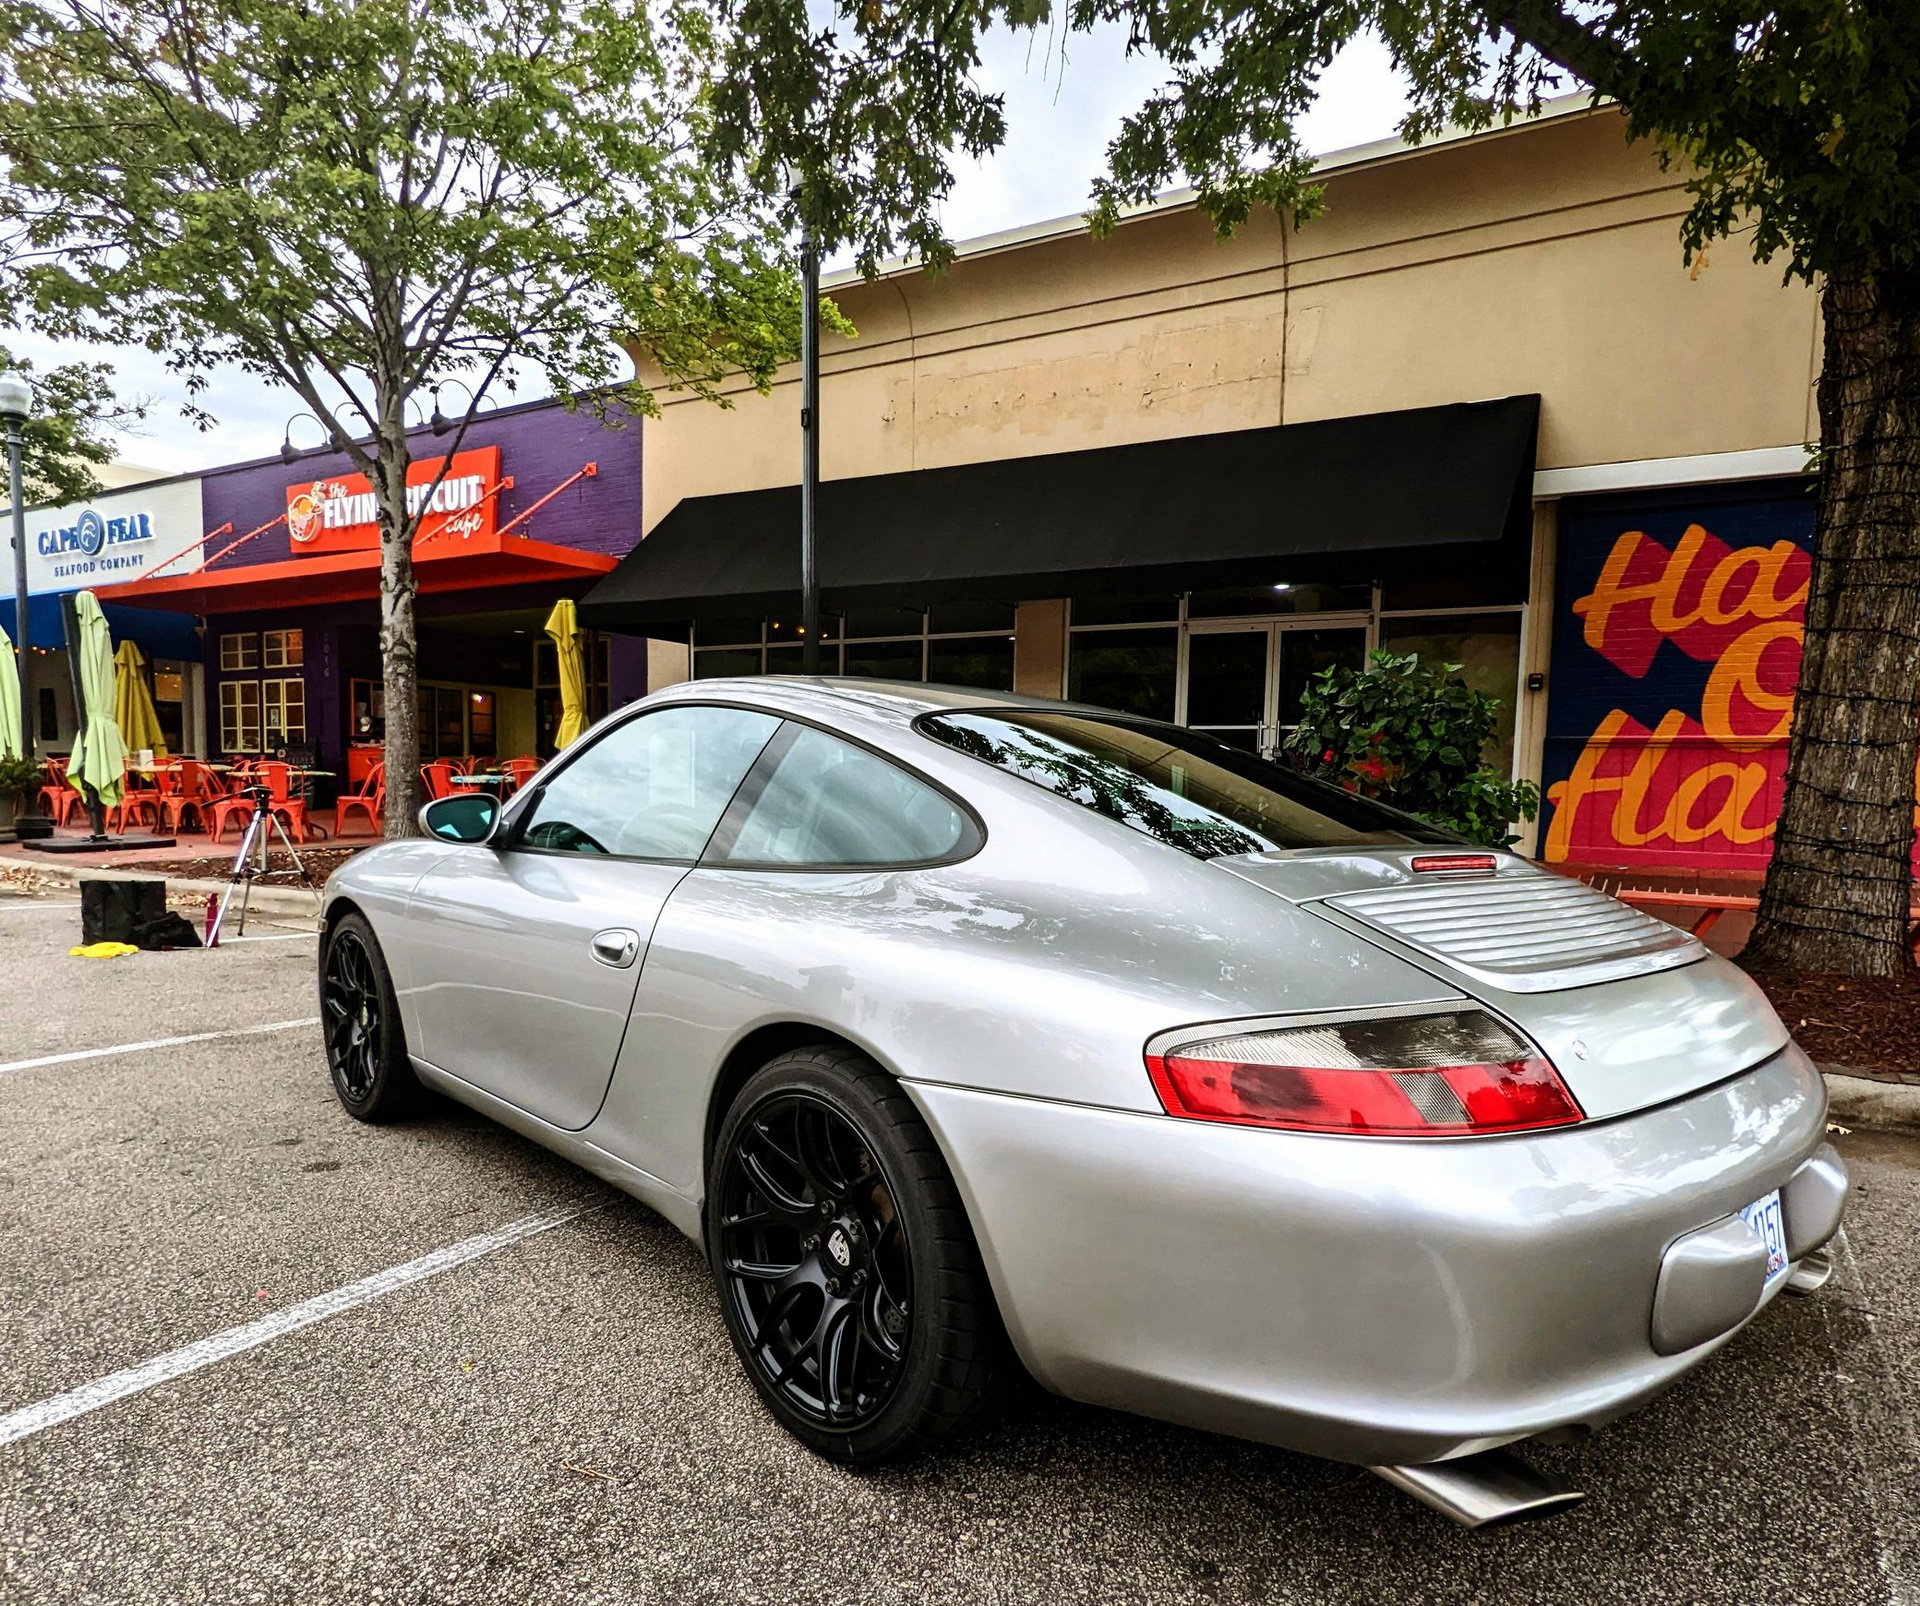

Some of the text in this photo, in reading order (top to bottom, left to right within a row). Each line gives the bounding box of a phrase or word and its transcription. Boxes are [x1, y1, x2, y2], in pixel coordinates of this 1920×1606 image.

[328, 482, 348, 498] the
[324, 492, 382, 529] FLYIN
[38, 513, 153, 556] CAPE FEAR
[54, 554, 144, 578] SEAFOOD COMPANY
